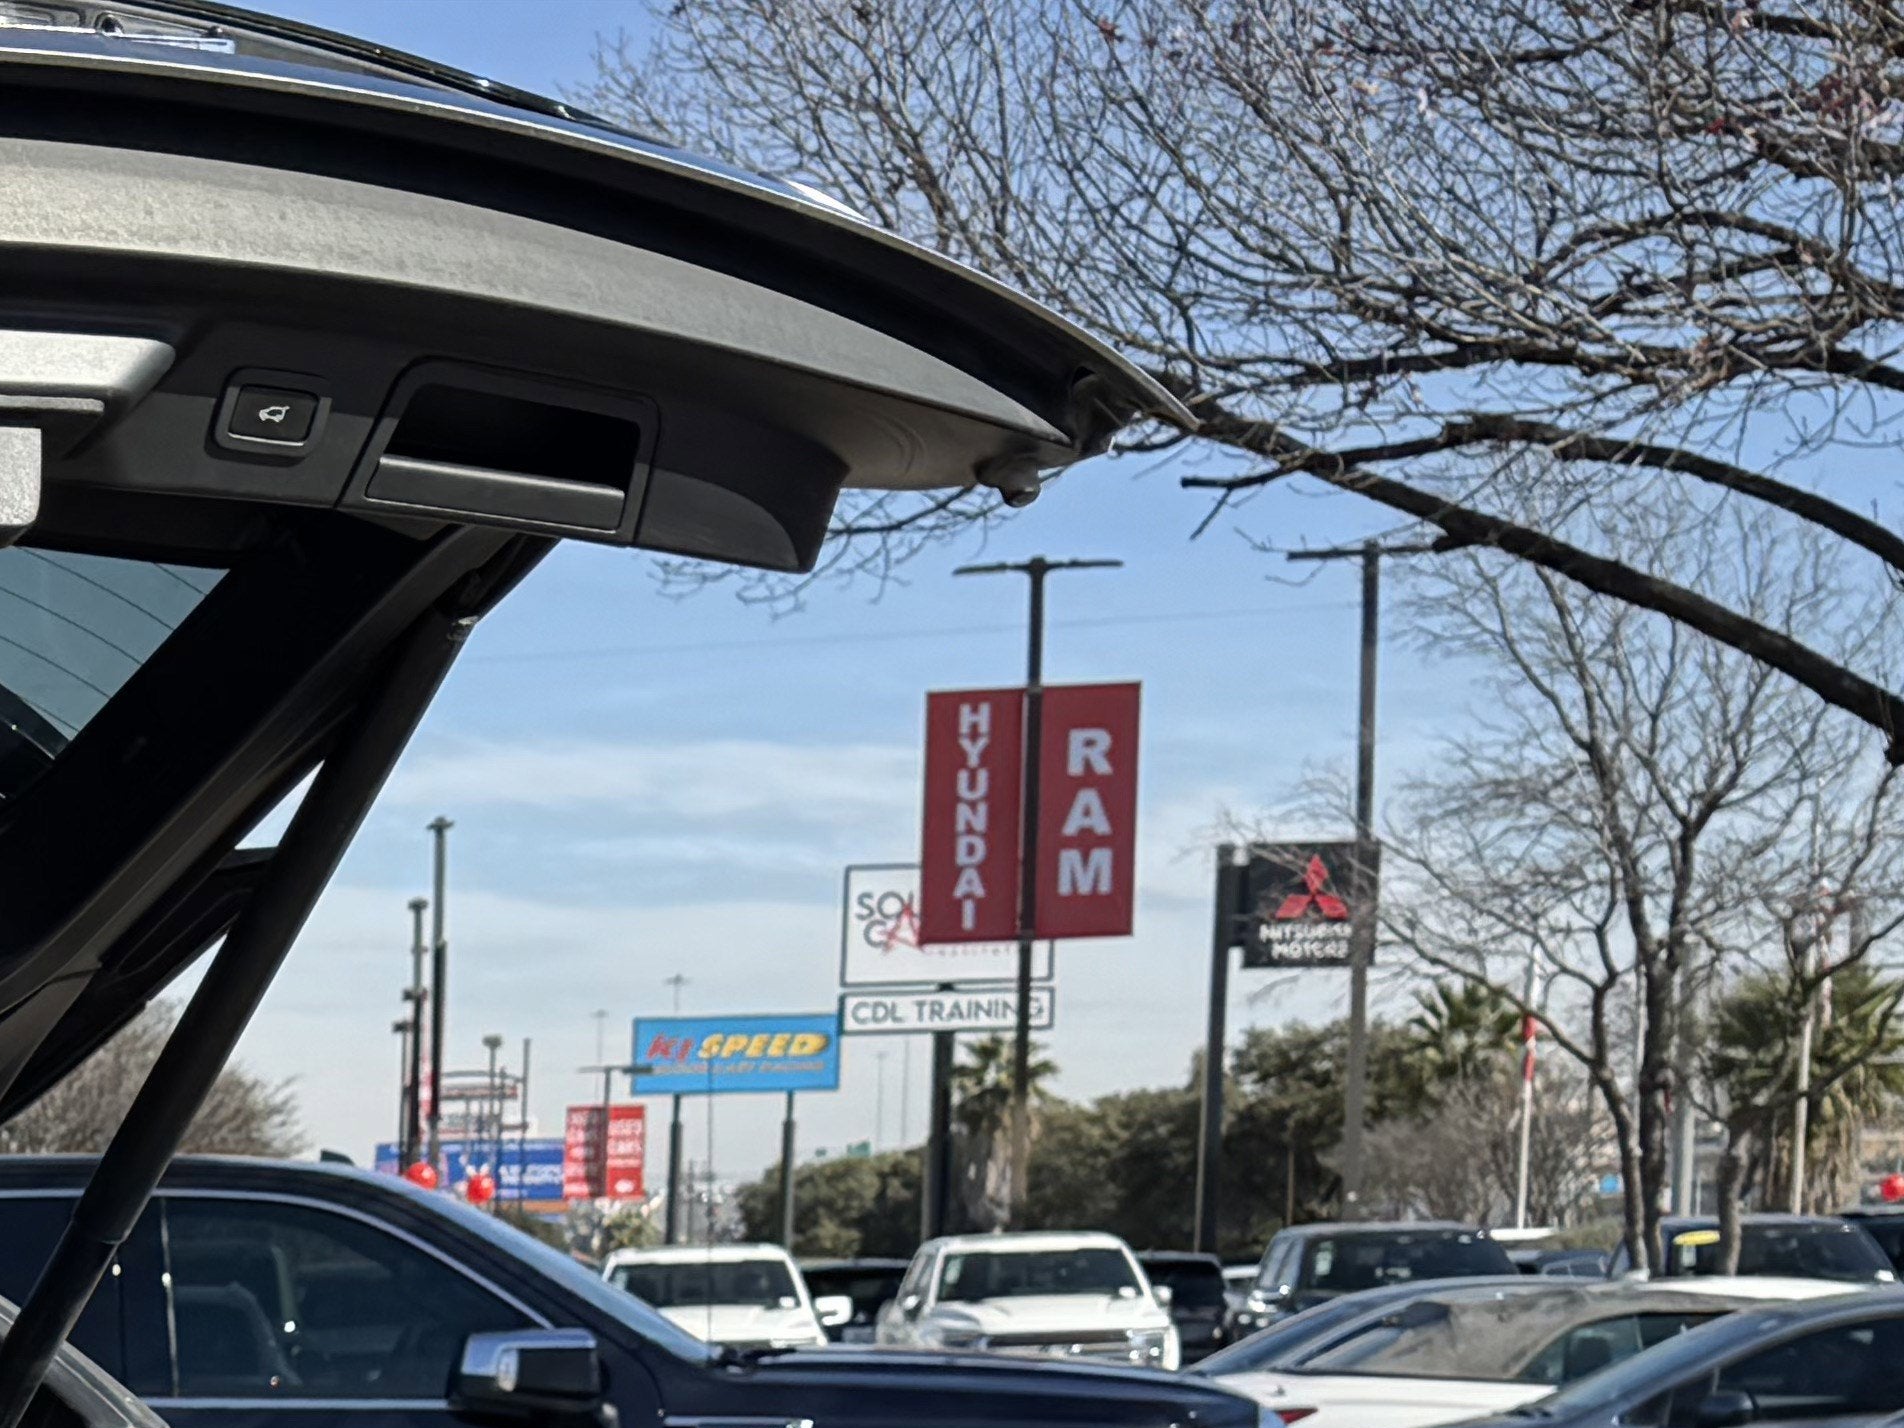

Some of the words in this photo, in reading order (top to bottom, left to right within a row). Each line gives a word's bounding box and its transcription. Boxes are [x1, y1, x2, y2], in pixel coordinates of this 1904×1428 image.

[953, 702, 990, 931] HYUNDAI
[1057, 728, 1114, 896] RAM
[698, 1032, 829, 1060] SPEED
[851, 1001, 905, 1025] CDL
